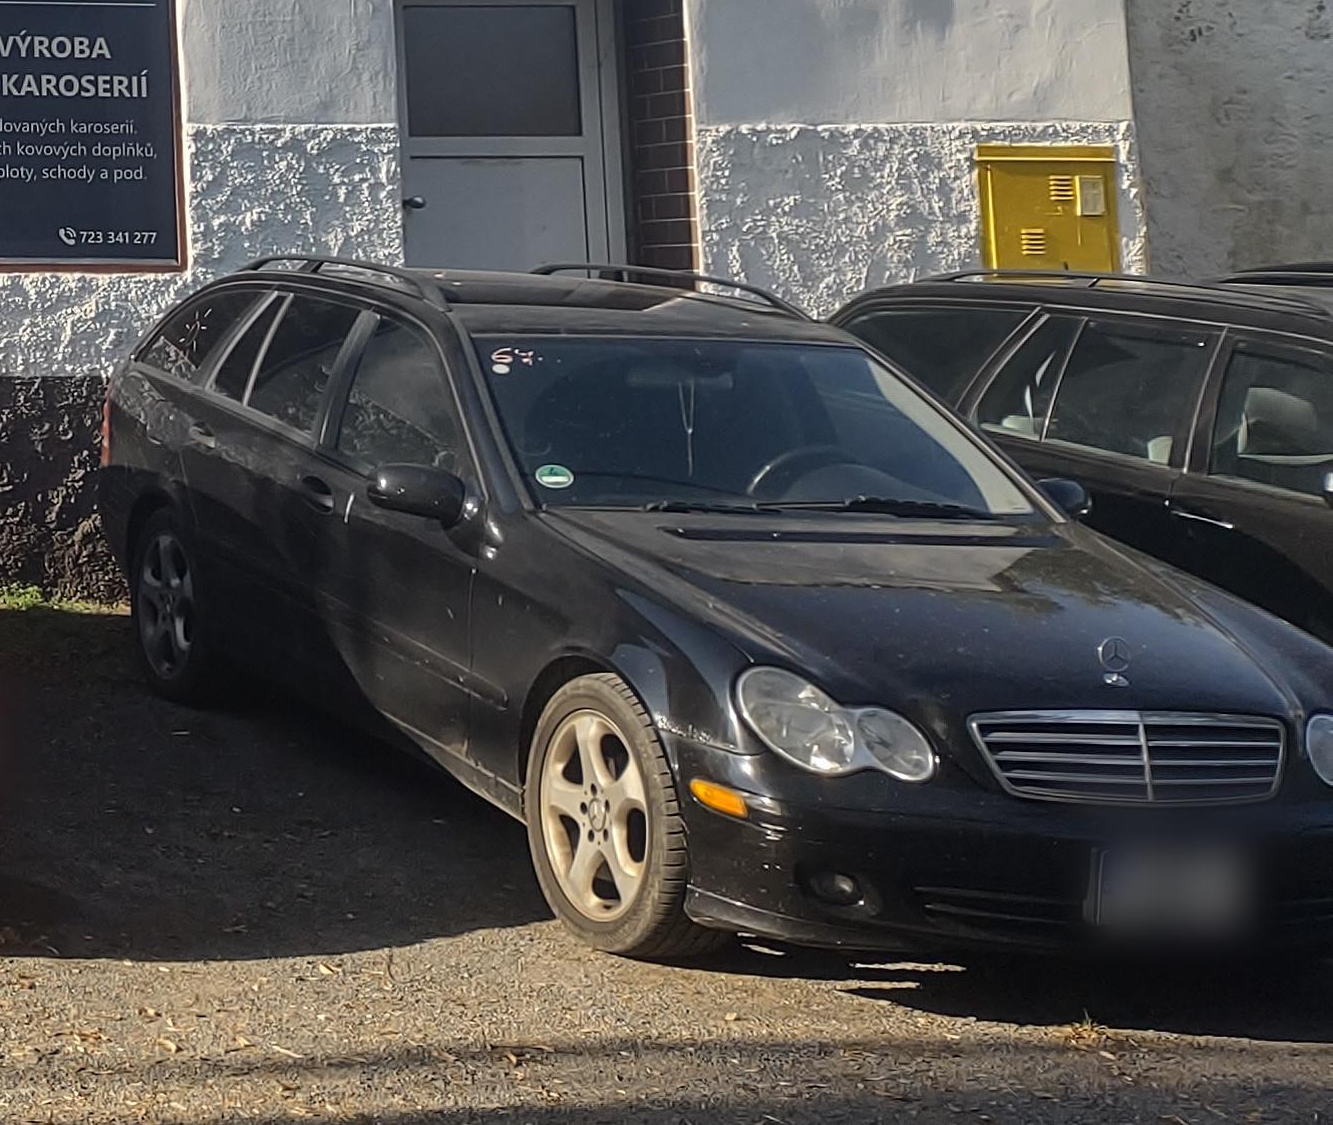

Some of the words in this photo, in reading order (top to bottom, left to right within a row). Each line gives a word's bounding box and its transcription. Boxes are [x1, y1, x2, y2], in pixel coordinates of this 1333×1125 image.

[2, 69, 149, 97] KAROSERIÍ
[70, 118, 138, 135] karoserií.
[17, 140, 87, 160] kovových
[91, 142, 157, 161] doplňků,
[41, 164, 95, 184] schody
[99, 168, 109, 180] a
[79, 231, 103, 244] 723
[107, 231, 129, 244] 341
[133, 232, 157, 244] 277
